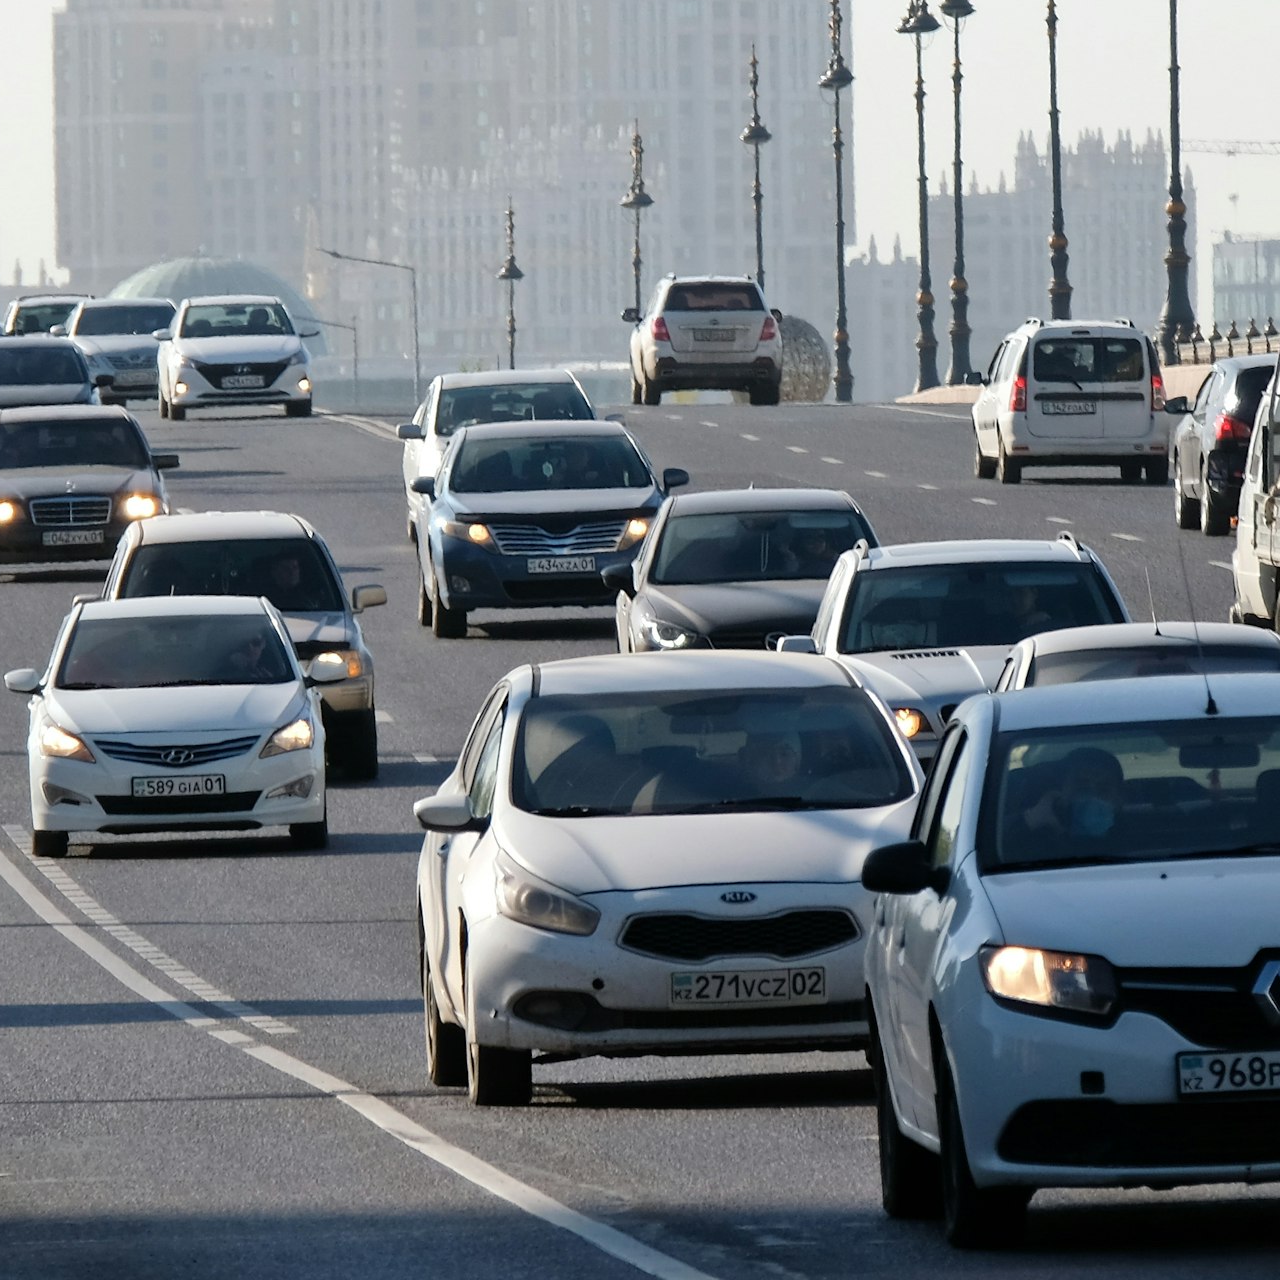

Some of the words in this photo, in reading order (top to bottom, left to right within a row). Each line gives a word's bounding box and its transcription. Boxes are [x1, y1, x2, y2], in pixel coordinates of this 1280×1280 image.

[146, 780, 174, 795] 589
[204, 777, 222, 792] 01
[725, 892, 752, 901] KIA
[674, 989, 693, 1000] KZ
[792, 971, 822, 996] 02
[1183, 1076, 1204, 1090] KZ
